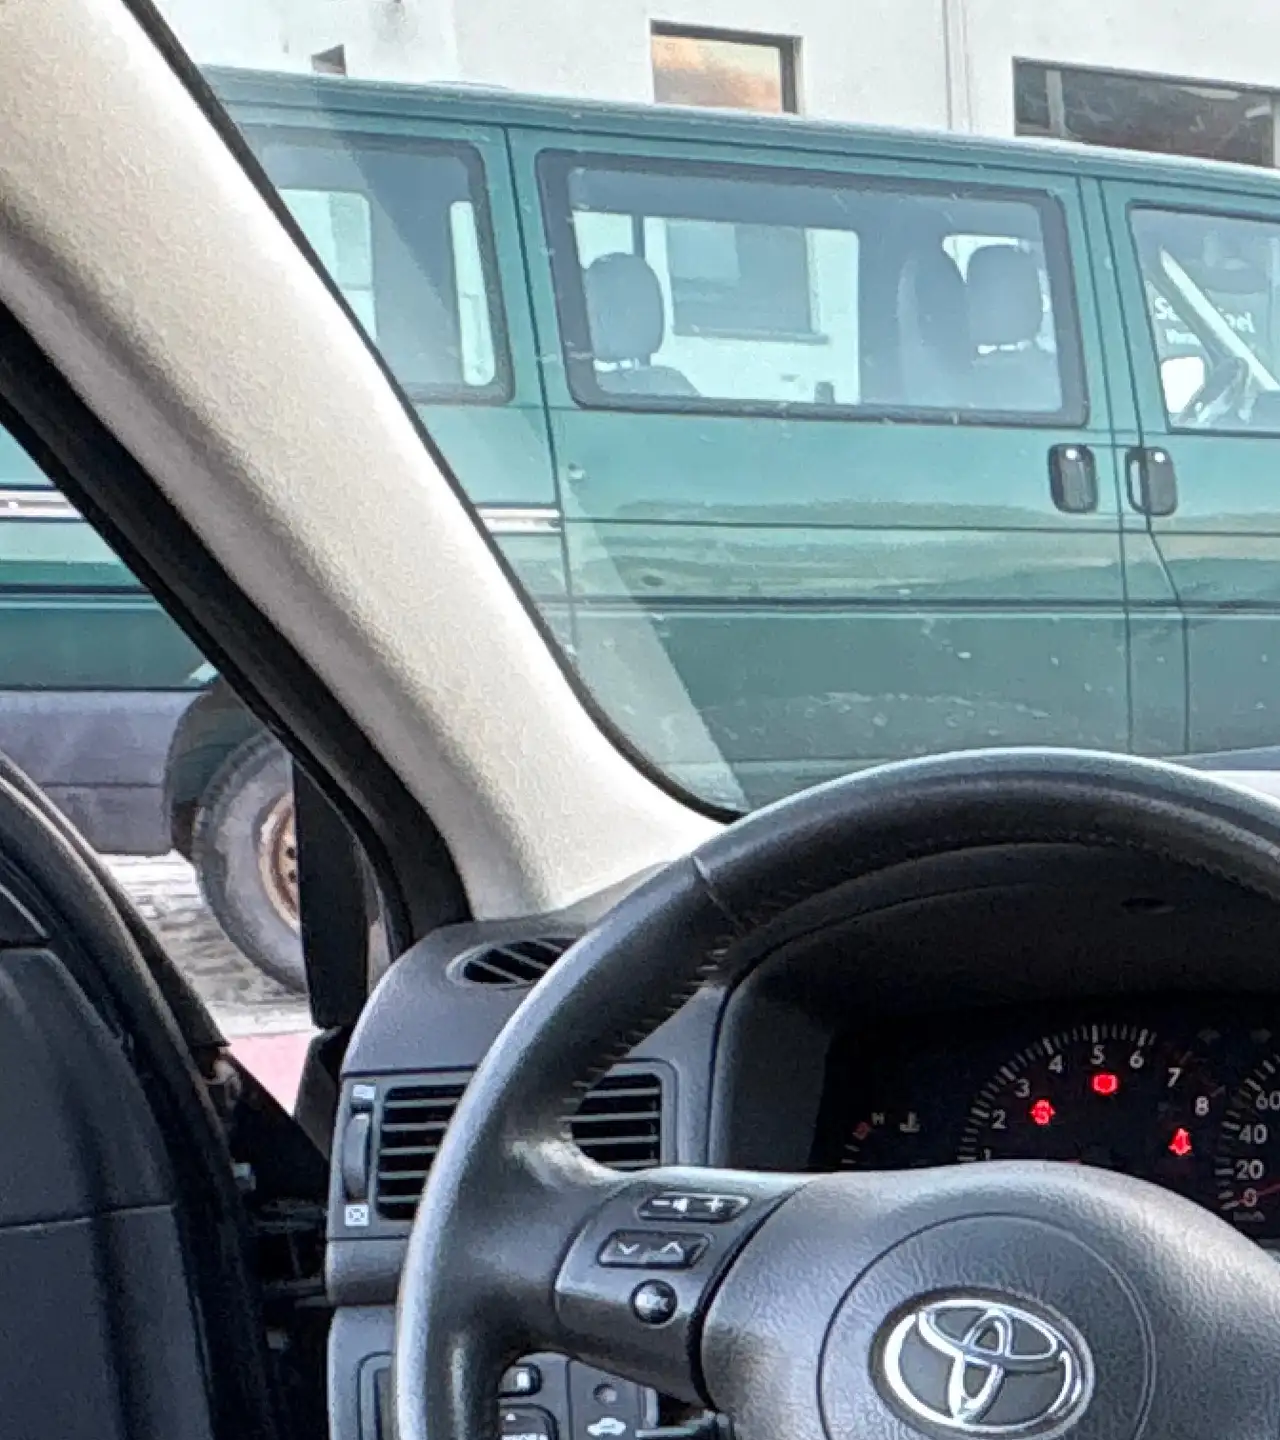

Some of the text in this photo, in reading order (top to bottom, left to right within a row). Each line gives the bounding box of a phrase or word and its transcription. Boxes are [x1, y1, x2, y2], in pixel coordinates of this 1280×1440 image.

[1048, 1054, 1064, 1074] 4
[1090, 1044, 1105, 1066] 5
[1129, 1050, 1144, 1070] 6
[1168, 1067, 1181, 1088] 7
[1015, 1078, 1031, 1099] 3
[1194, 1095, 1210, 1117] 8
[991, 1109, 1007, 1130] 2
[1238, 1123, 1268, 1145] 40
[1235, 1159, 1264, 1180] 20
